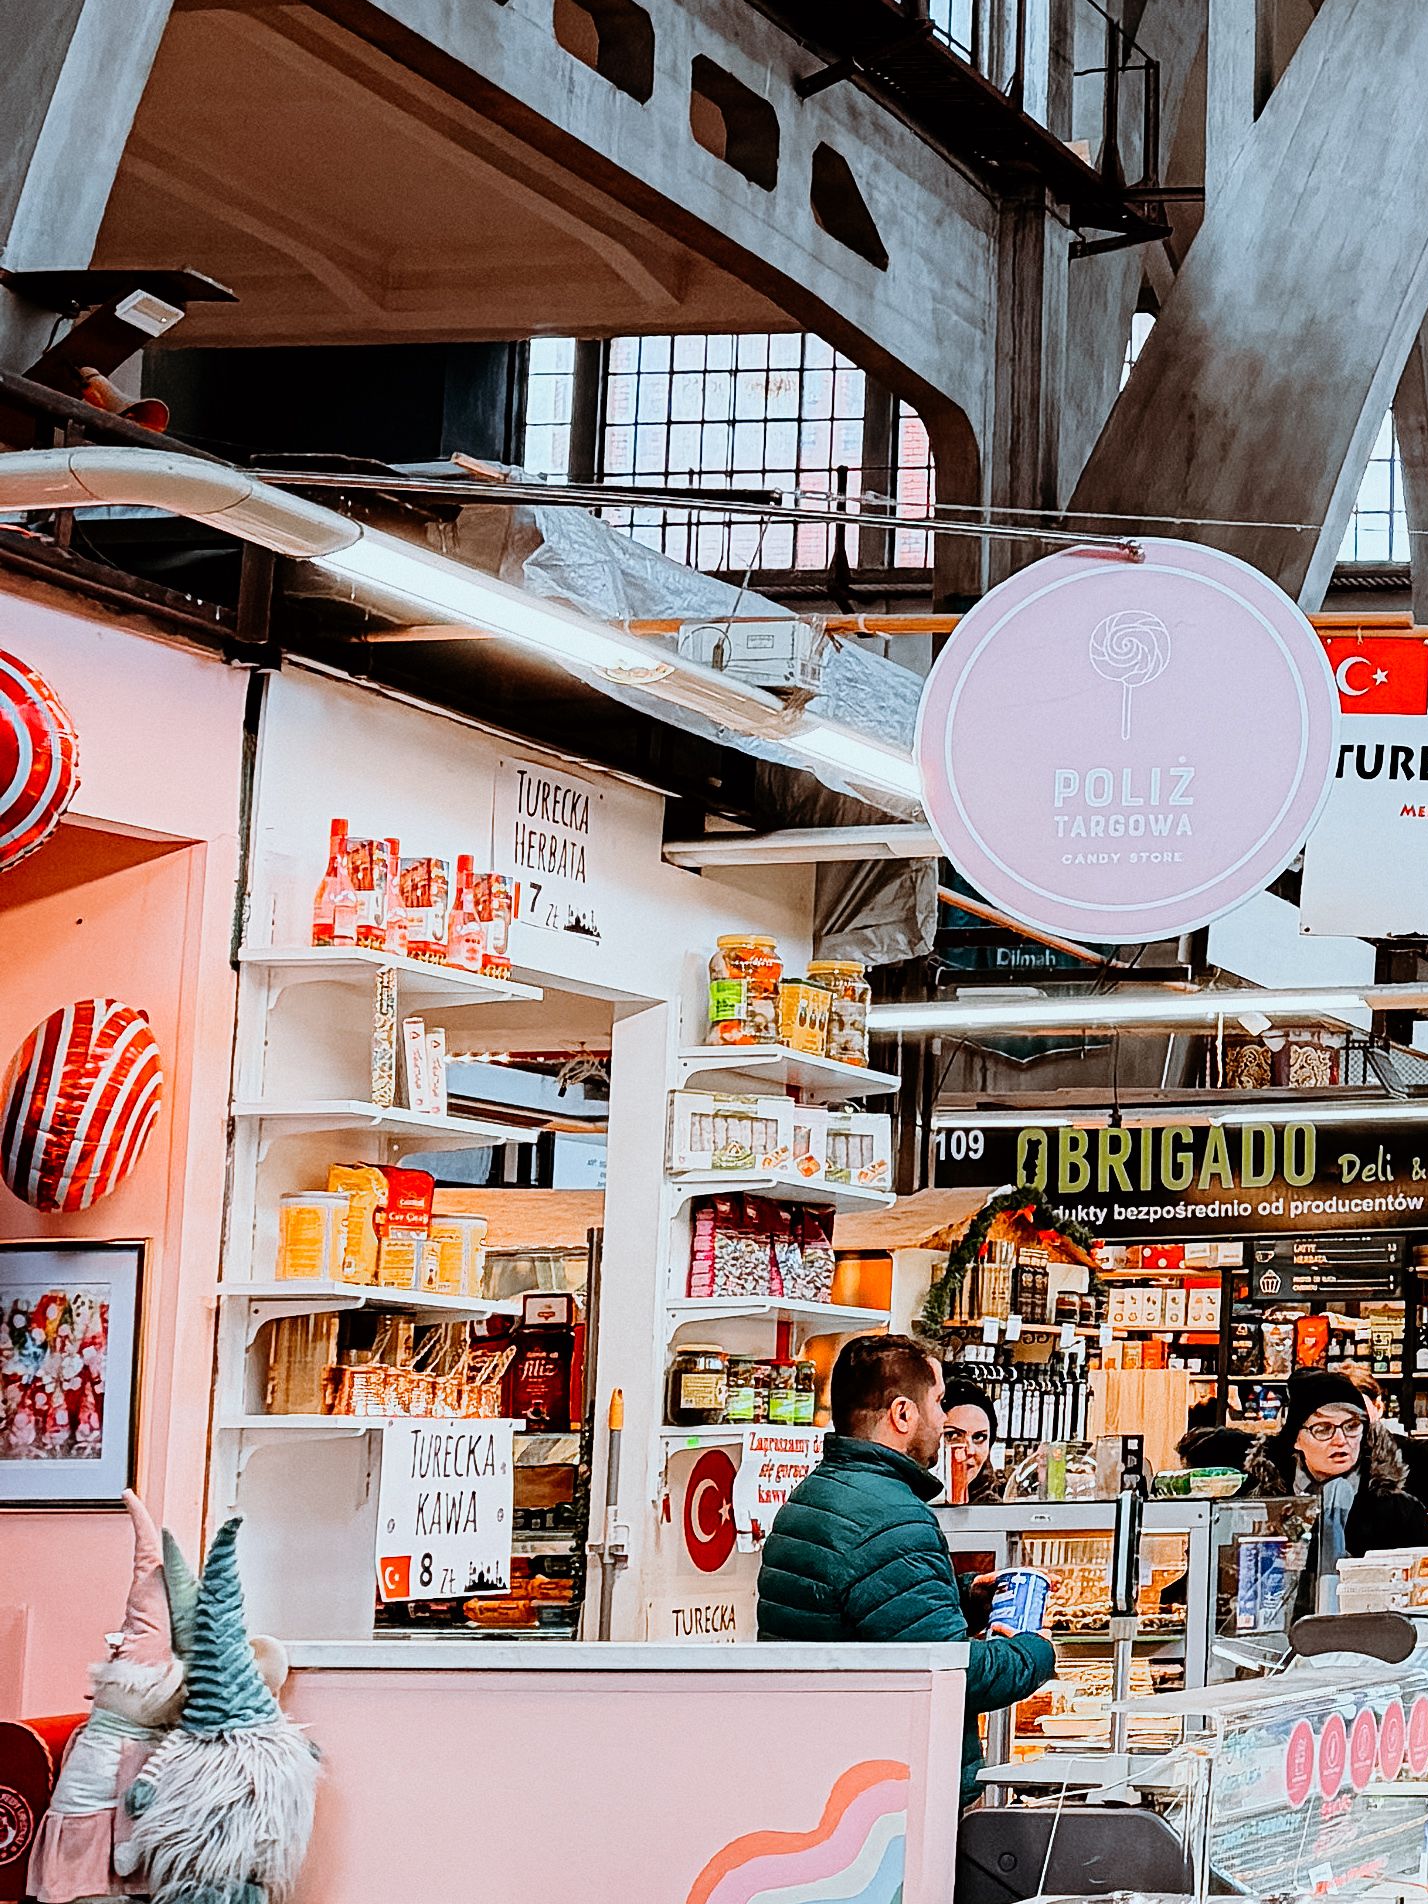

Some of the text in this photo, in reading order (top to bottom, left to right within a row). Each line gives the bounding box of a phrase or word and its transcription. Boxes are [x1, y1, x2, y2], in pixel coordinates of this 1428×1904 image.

[1054, 756, 1195, 808] POLIŻ
[517, 769, 590, 834] TURECKA
[1054, 813, 1193, 838] TARGOWA
[514, 821, 586, 884] HERBATA
[1061, 852, 1184, 865] CANDY STORE
[530, 882, 542, 912] 7
[997, 947, 1057, 969] Dilmah
[935, 1130, 984, 1160] 109
[1017, 1121, 1317, 1194] OBRIGADO
[1339, 1146, 1394, 1184] Deli
[1411, 1156, 1427, 1180] &
[1053, 1194, 1425, 1226] dukty bezpośrednio od producentów
[411, 1429, 495, 1478] TURECKA
[750, 1432, 810, 1458] Zapraszamy
[416, 1491, 477, 1535] KAWA
[420, 1552, 432, 1587] 8
[672, 1604, 736, 1636] TURECKA
